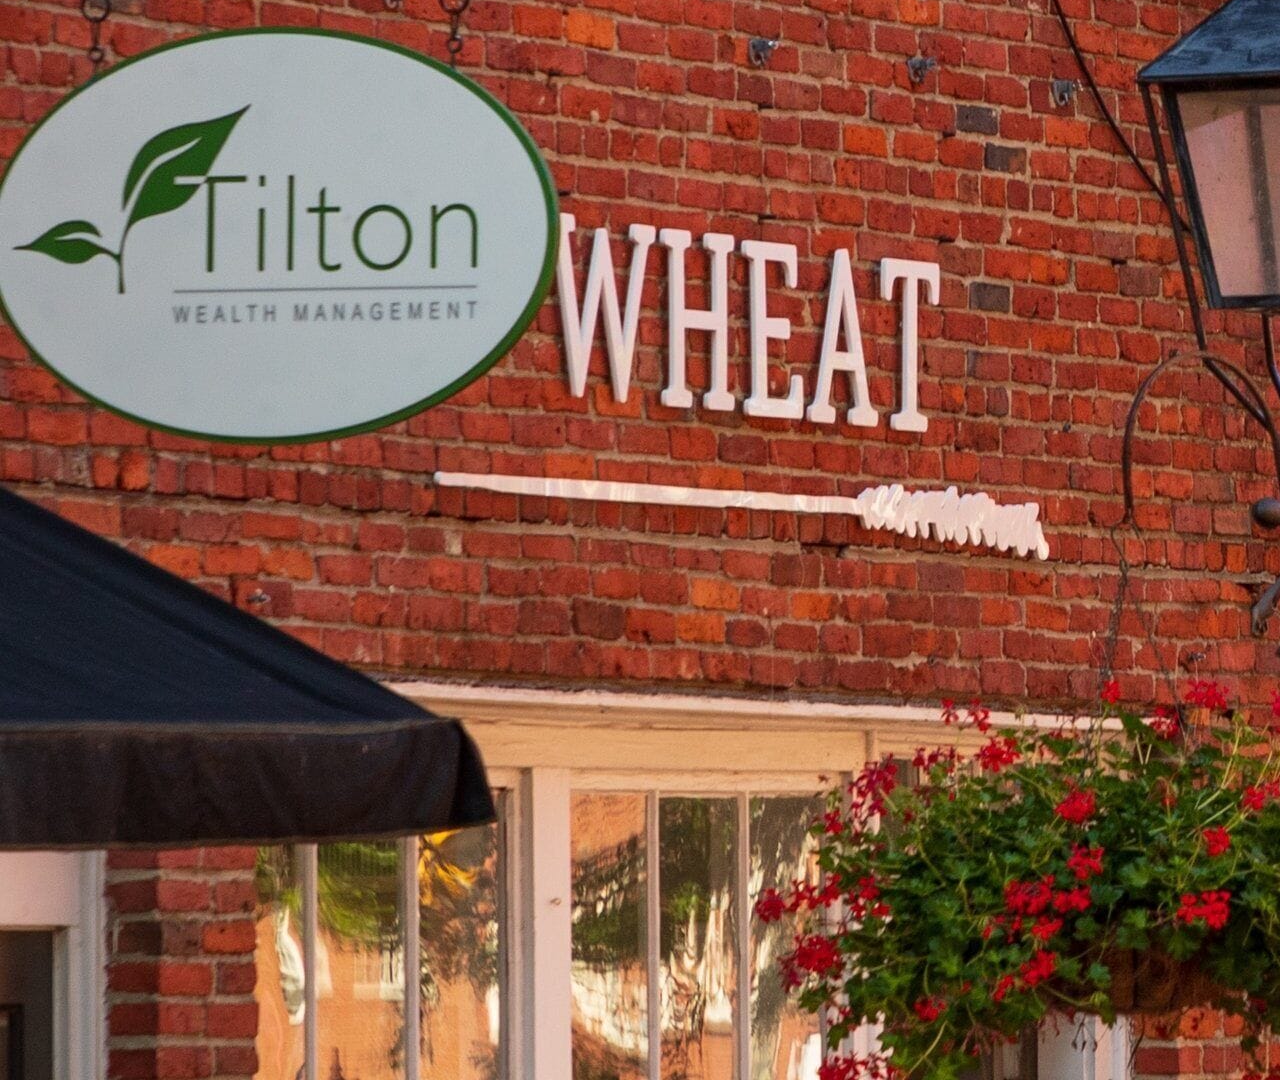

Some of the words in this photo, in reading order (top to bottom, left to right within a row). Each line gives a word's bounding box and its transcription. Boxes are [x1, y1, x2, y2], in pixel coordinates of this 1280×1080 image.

[174, 174, 479, 273] Tilton
[173, 303, 278, 324] WEALTH
[293, 300, 480, 322] MANAGEMENT
[558, 212, 941, 433] WHEAT
